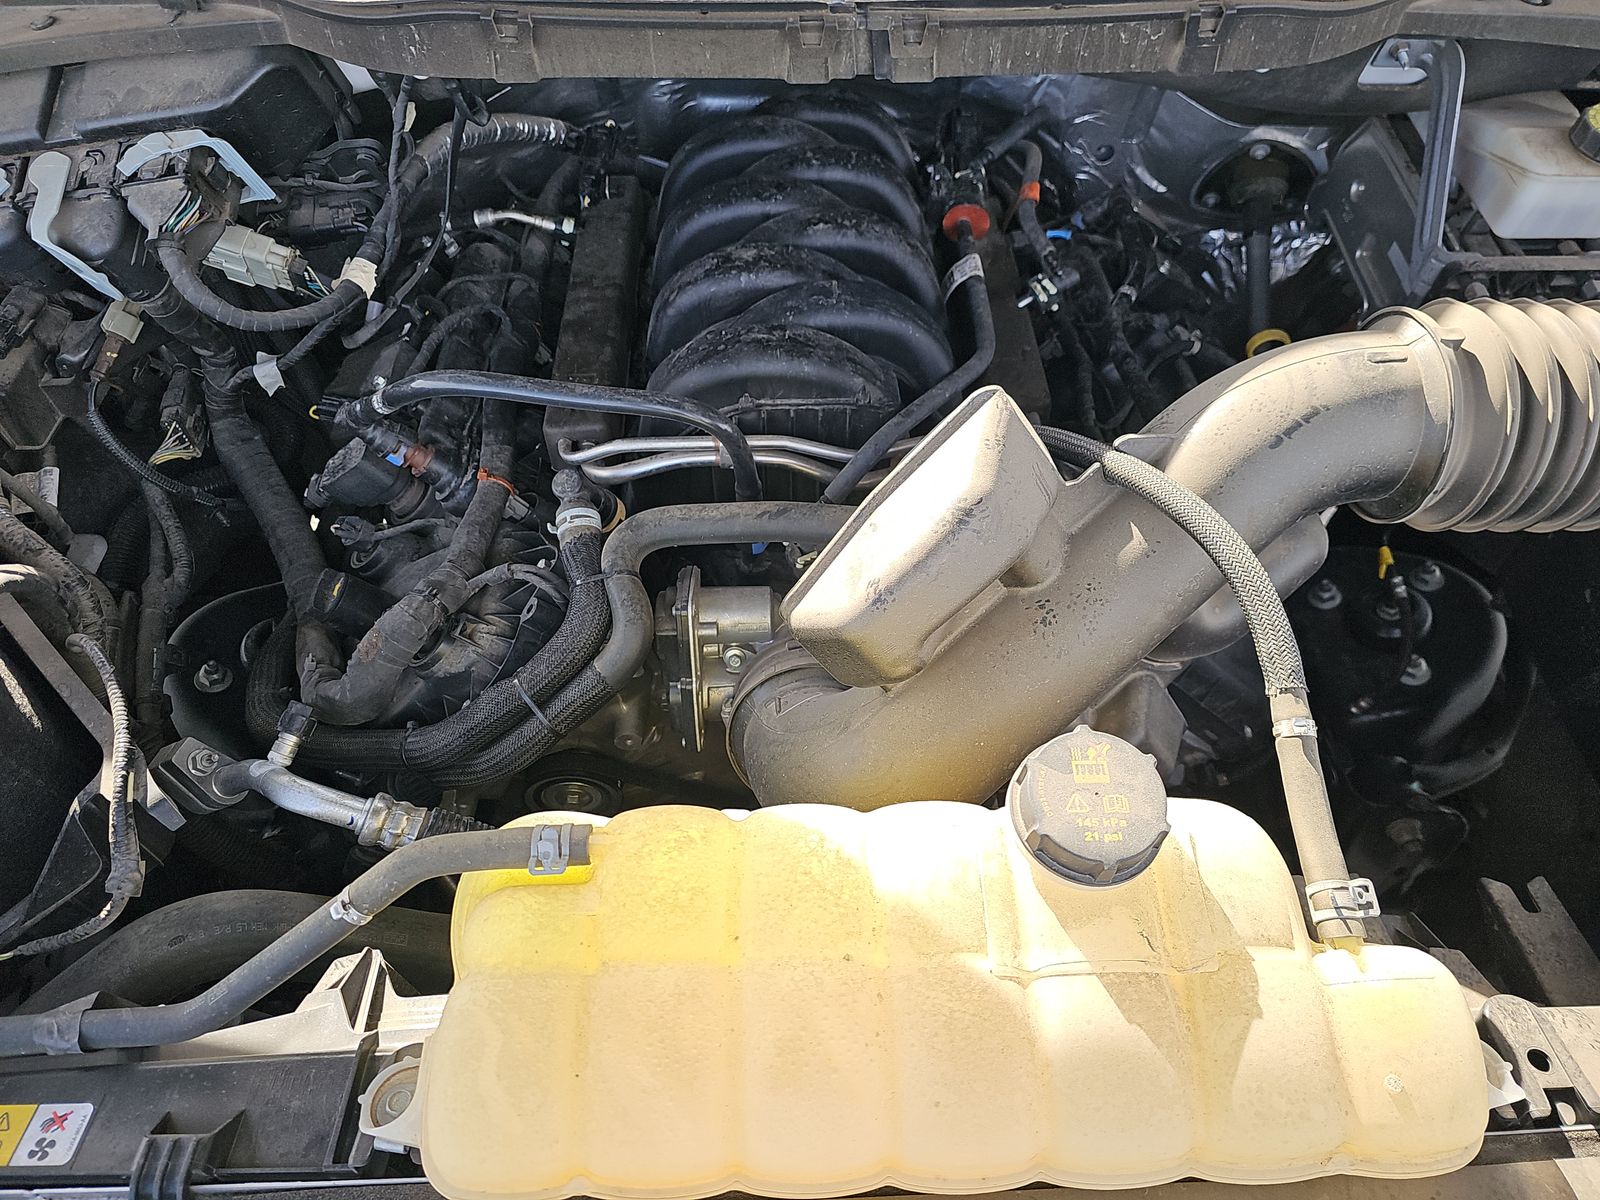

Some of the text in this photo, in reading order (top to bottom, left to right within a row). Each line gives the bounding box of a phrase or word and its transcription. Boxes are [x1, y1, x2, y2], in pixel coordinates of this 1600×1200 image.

[1103, 817, 1126, 827] kPa
[1084, 831, 1123, 842] 21 psi
